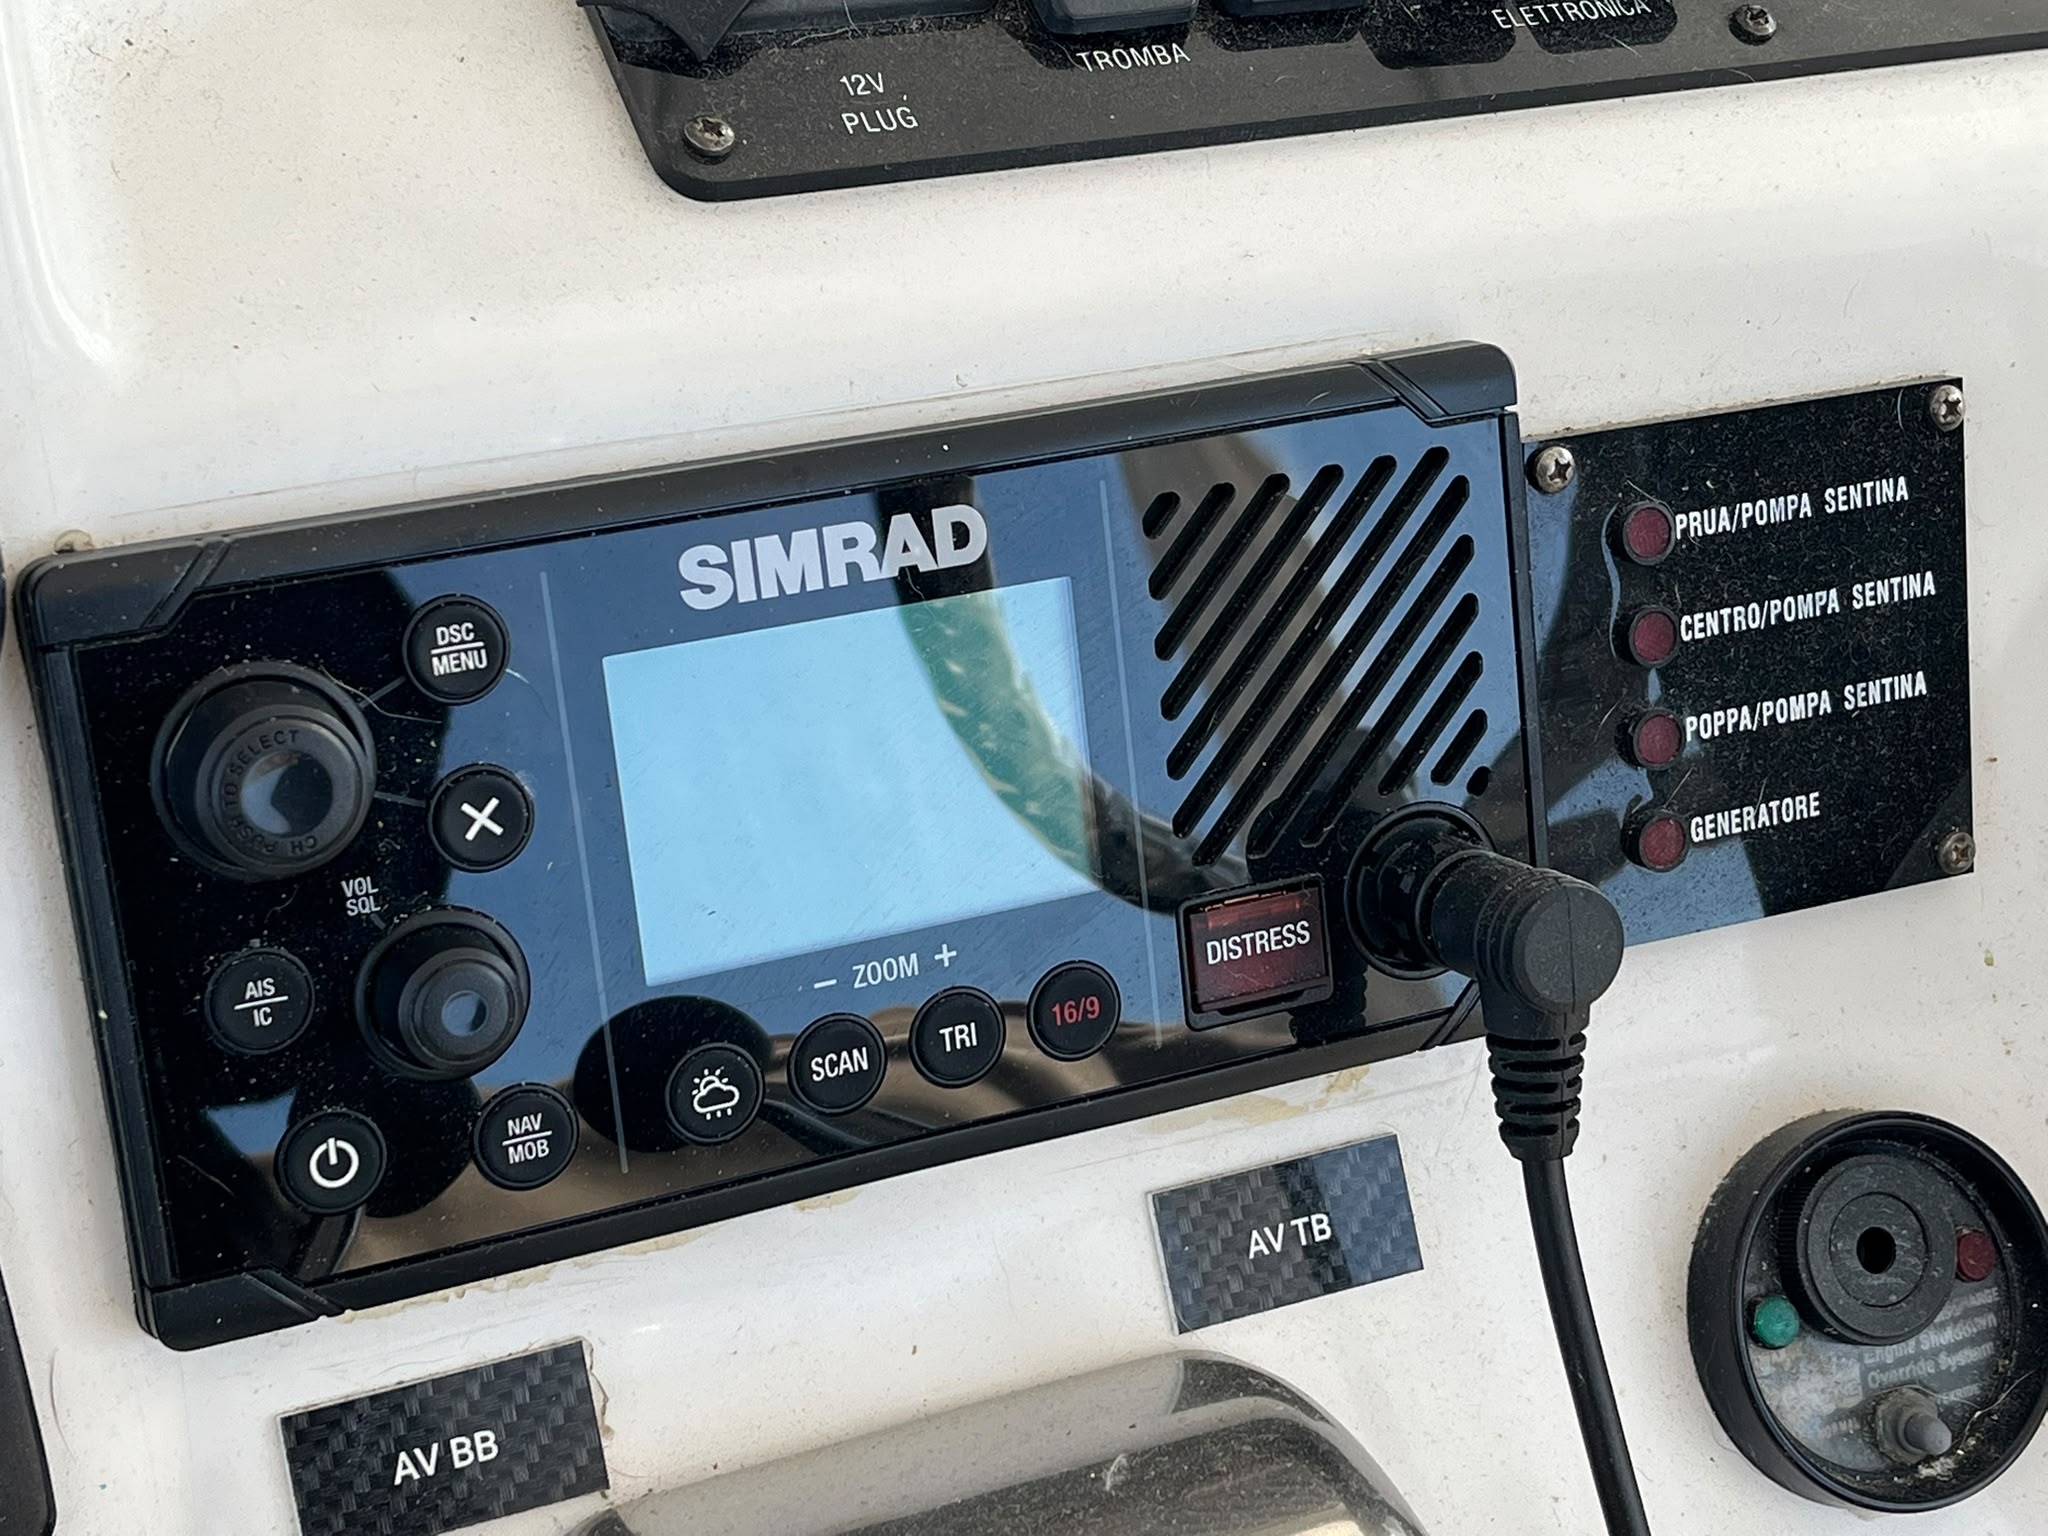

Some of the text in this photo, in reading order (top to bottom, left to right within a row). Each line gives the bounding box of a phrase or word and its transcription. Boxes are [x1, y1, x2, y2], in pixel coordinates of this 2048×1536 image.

[1491, 0, 1652, 29] ELETTRONICA
[1076, 43, 1191, 72] TROMBA
[839, 72, 884, 96] 12V
[841, 106, 919, 135] PLUG
[1675, 475, 1909, 540] PRUA/POMPA SENTINA
[678, 504, 988, 611] SIMRAD
[1680, 570, 1936, 642] CENTRO/POMPA SENTINA
[435, 622, 475, 644] DSC
[431, 650, 488, 677] MENU
[1685, 670, 1928, 743] POPPA/POMPA SENTINA
[229, 729, 299, 776] SELECT
[223, 782, 239, 809] TO
[1690, 791, 1820, 843] GENERATORE
[227, 814, 279, 853] PUSH
[341, 876, 379, 898] VOL
[346, 895, 381, 916] SQL
[1206, 920, 1310, 965] DISTRESS
[852, 953, 920, 989] ZOOM
[245, 977, 276, 999] AIS
[252, 1005, 273, 1028] IC
[1052, 996, 1100, 1025] 16/9
[938, 1022, 978, 1052] TRI
[811, 1046, 869, 1082] SCAN
[507, 1112, 543, 1138] NAV
[507, 1138, 550, 1164] MOB
[1248, 1213, 1332, 1260] AV TB
[1867, 1360, 1935, 1388] Override
[394, 1430, 499, 1486] AV BB
